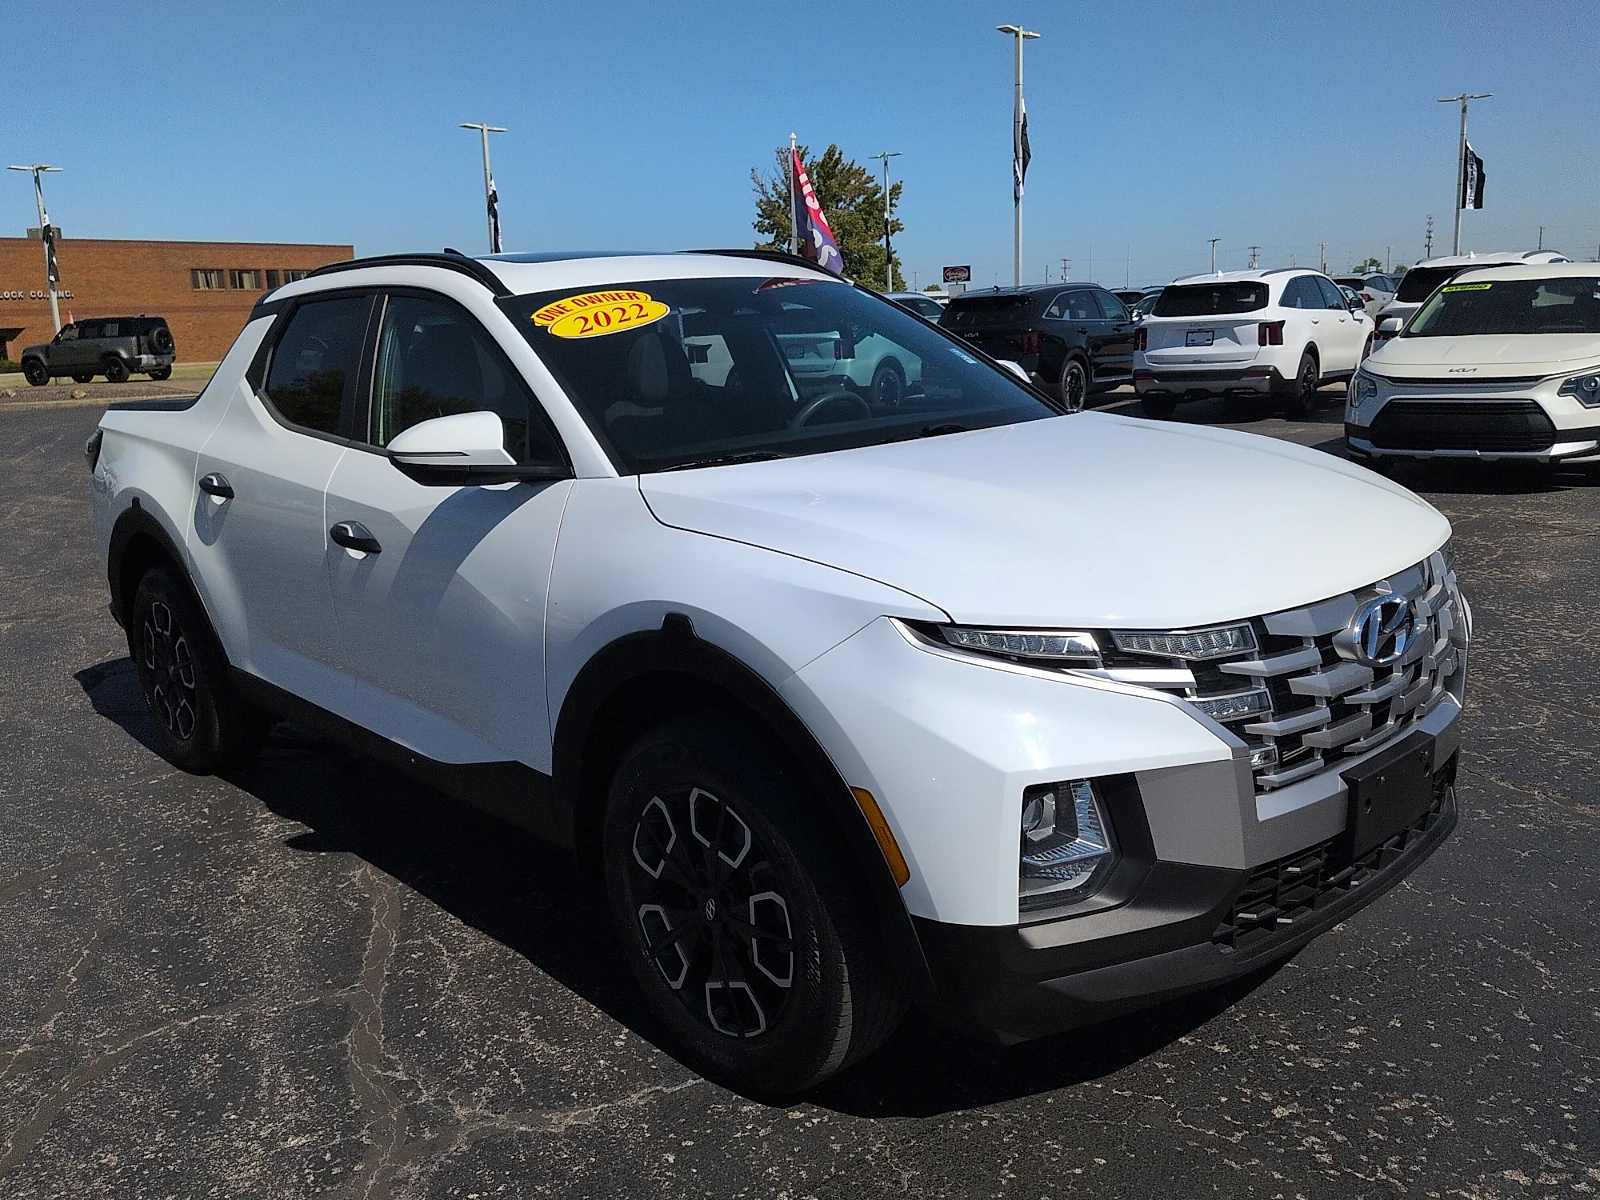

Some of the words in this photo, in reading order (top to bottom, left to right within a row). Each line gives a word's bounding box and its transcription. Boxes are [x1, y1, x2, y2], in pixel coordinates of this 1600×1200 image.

[56, 289, 74, 299] NC.
[536, 303, 572, 322] ONE
[572, 291, 640, 307] OWNER
[574, 303, 649, 334] 2022
